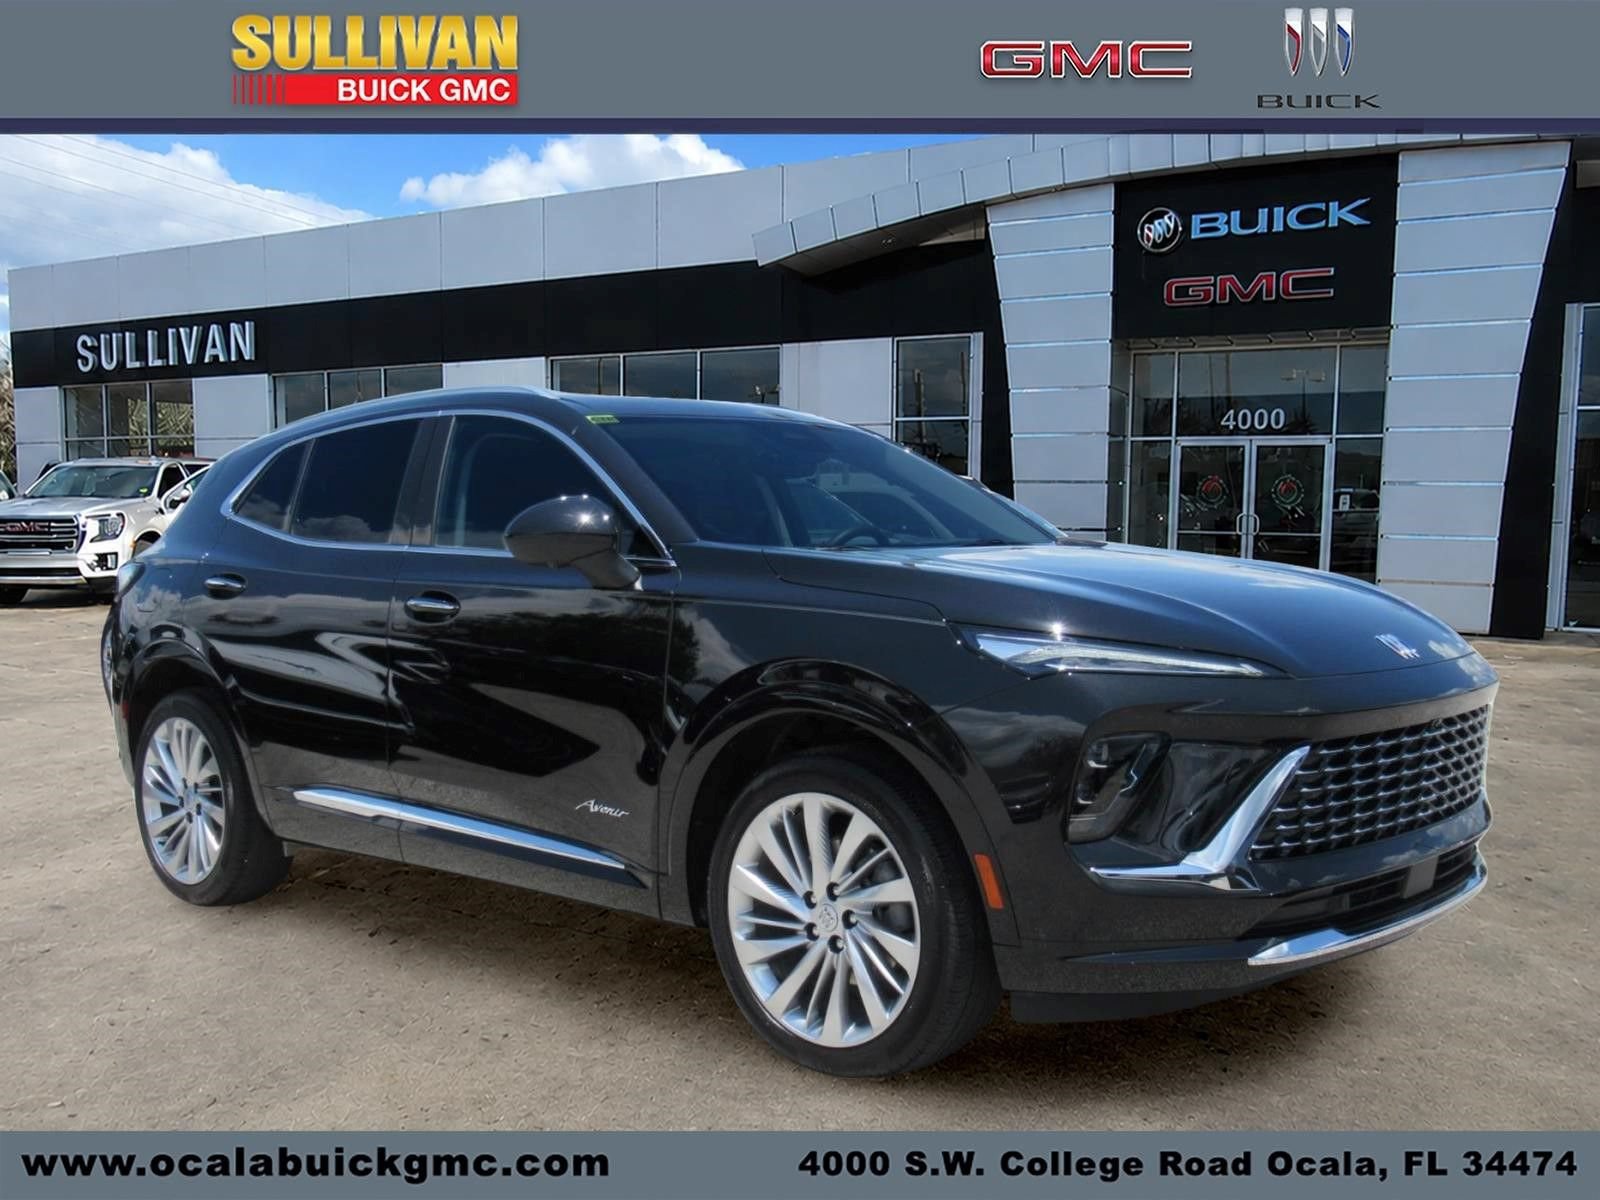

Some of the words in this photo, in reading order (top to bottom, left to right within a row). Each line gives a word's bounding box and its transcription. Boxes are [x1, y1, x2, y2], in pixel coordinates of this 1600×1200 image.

[1190, 197, 1371, 240] BUICK
[1163, 266, 1335, 307] GMC
[76, 320, 256, 373] SULLIVAN
[1220, 407, 1286, 431] 4000
[4, 521, 50, 532] GMC
